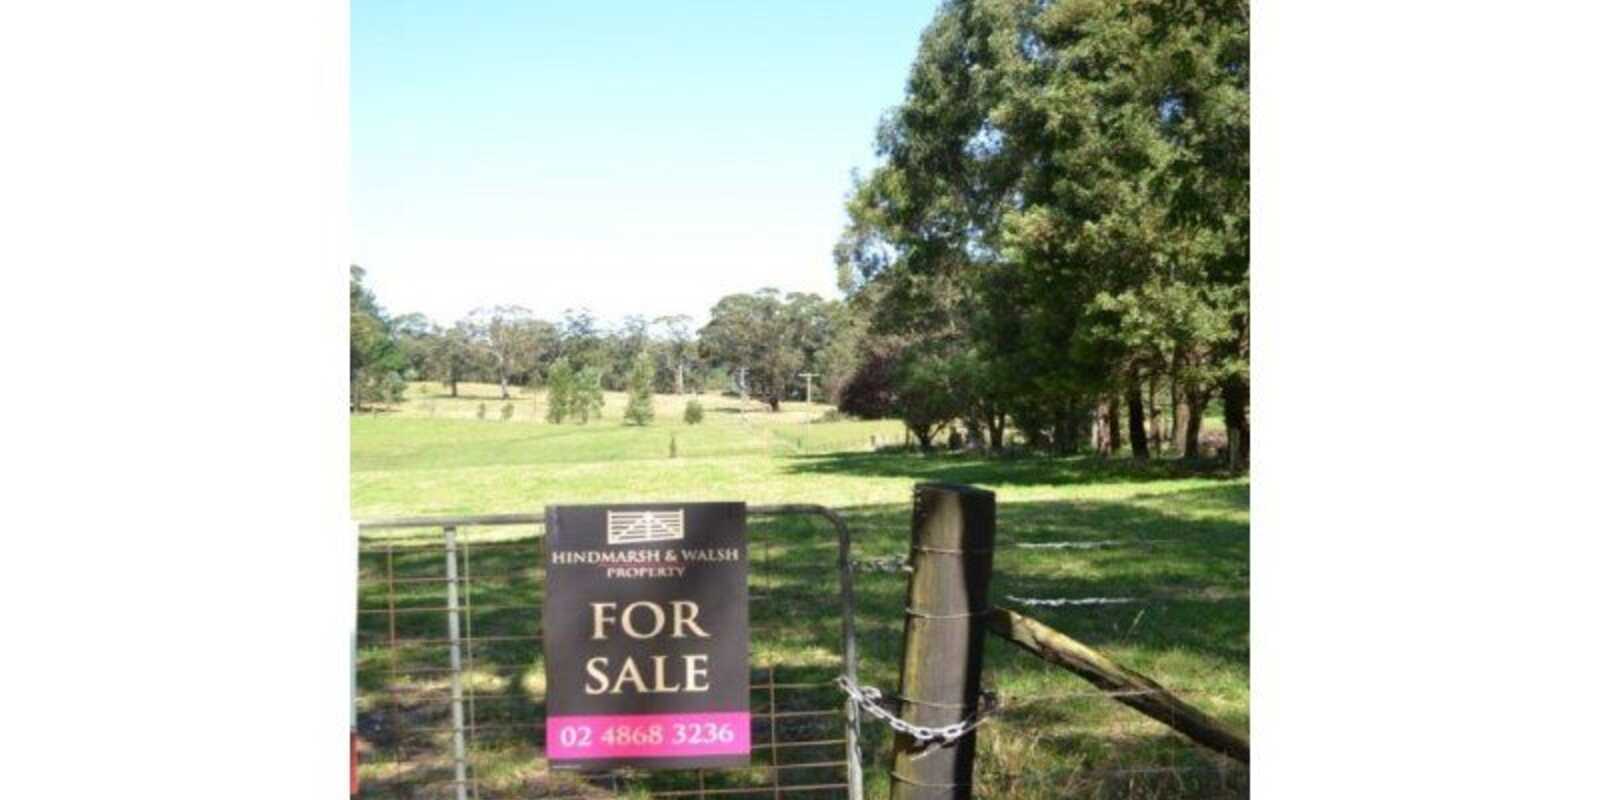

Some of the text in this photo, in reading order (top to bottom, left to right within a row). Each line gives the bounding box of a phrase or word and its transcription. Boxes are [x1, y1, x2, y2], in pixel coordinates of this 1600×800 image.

[552, 548, 739, 564] HINDMARSH & WALSH
[607, 567, 686, 578] PROPERTY
[589, 601, 712, 640] FOR
[585, 654, 710, 695] SALE
[560, 722, 735, 747] 02 4868 3236
